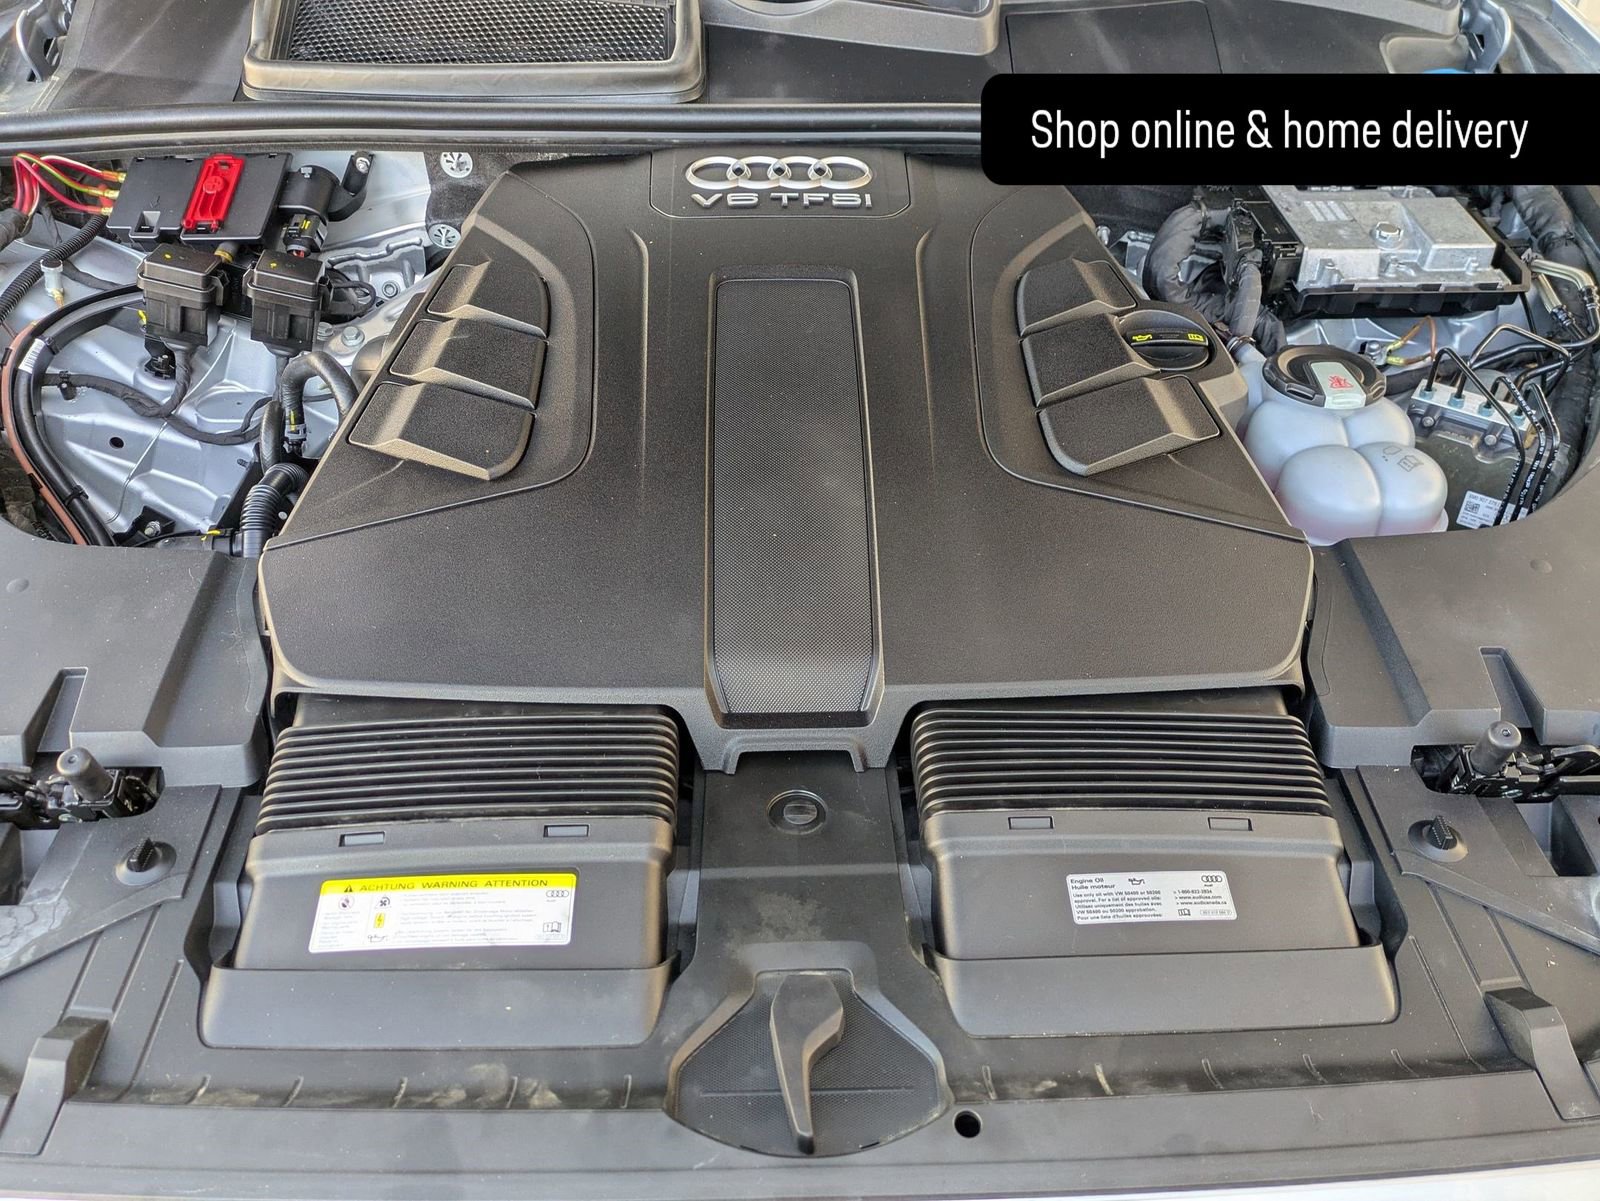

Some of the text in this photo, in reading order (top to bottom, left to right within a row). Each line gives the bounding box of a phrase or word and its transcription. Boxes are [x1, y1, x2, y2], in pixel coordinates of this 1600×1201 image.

[691, 192, 873, 209] V6 TFSI
[359, 879, 549, 892] ACHTUNG WARNING ATTENTION
